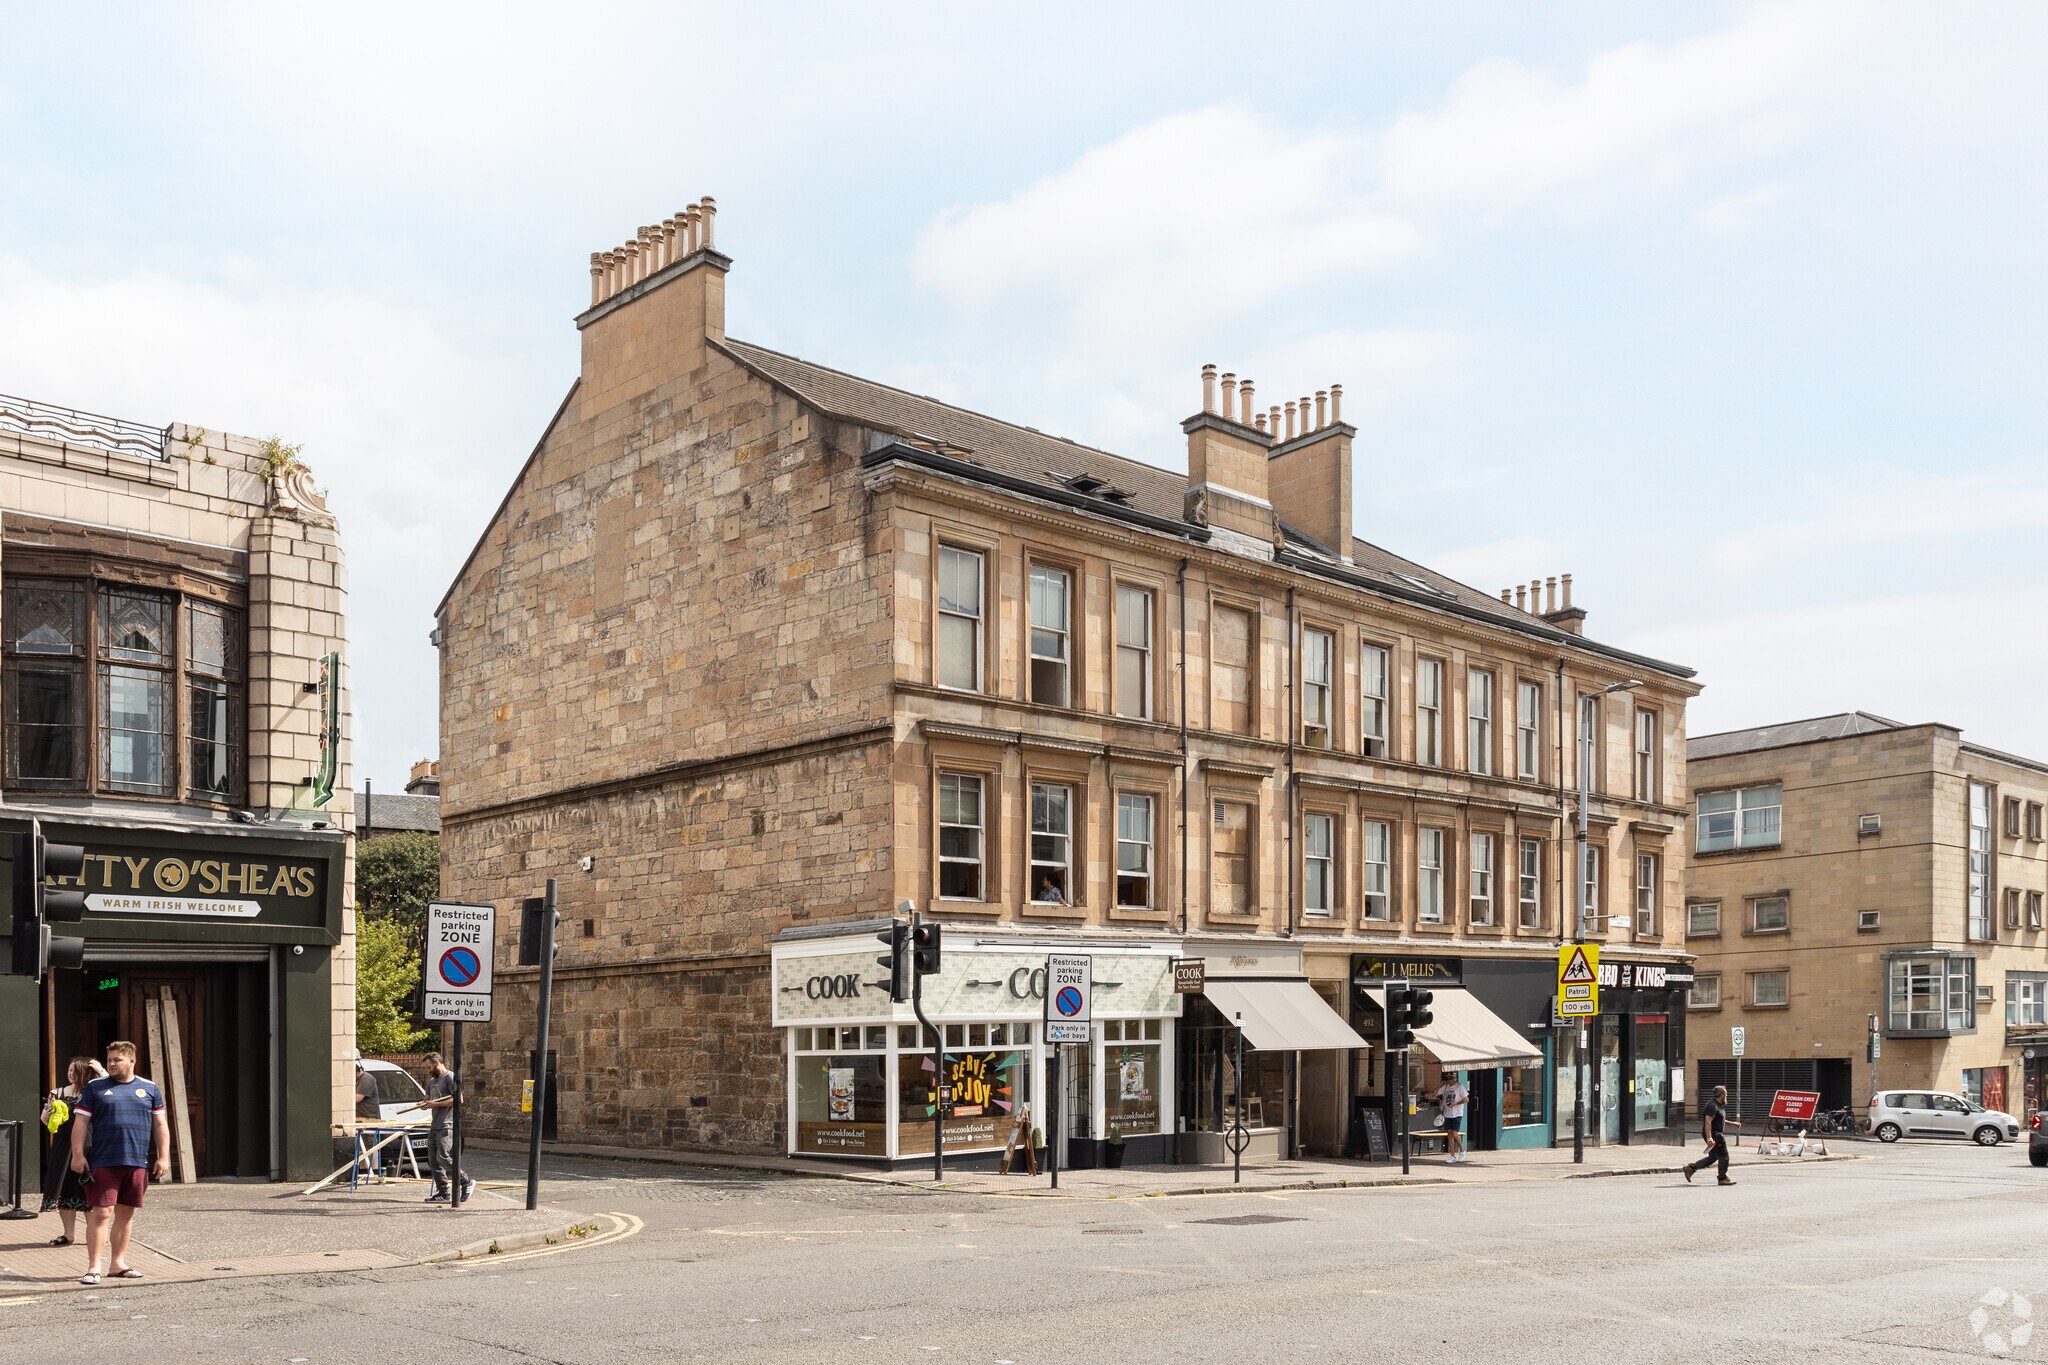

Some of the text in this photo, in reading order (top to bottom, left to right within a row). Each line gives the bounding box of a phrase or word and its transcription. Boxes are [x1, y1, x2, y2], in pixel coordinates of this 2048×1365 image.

[153, 857, 315, 898] O'SHEA'S
[102, 898, 244, 913] WARM IRISH WELCOME
[434, 909, 489, 921] Restricted
[441, 922, 481, 933] parking
[441, 932, 480, 944] ZONE
[1052, 958, 1088, 967] Restricted
[1056, 967, 1083, 975] parking
[1176, 968, 1202, 979] COOK
[1400, 963, 1434, 977] MELLIS
[1597, 964, 1619, 987] BBQ
[1635, 966, 1666, 987] KINGS
[1056, 975, 1083, 984] ZONE
[806, 973, 861, 1000] COOK
[431, 997, 485, 1008] Park only in
[1580, 1003, 1591, 1011] yds
[430, 1008, 485, 1017] signed bays
[1363, 1019, 1374, 1027] 492
[1050, 1031, 1086, 1040] sied bays
[952, 1054, 987, 1081] SERVE
[952, 1077, 991, 1108] UP JOY
[1109, 1110, 1156, 1120] www.cookfood.net
[816, 1128, 866, 1138] www.cookfood.net
[942, 1123, 994, 1134] www.cookfood.net
